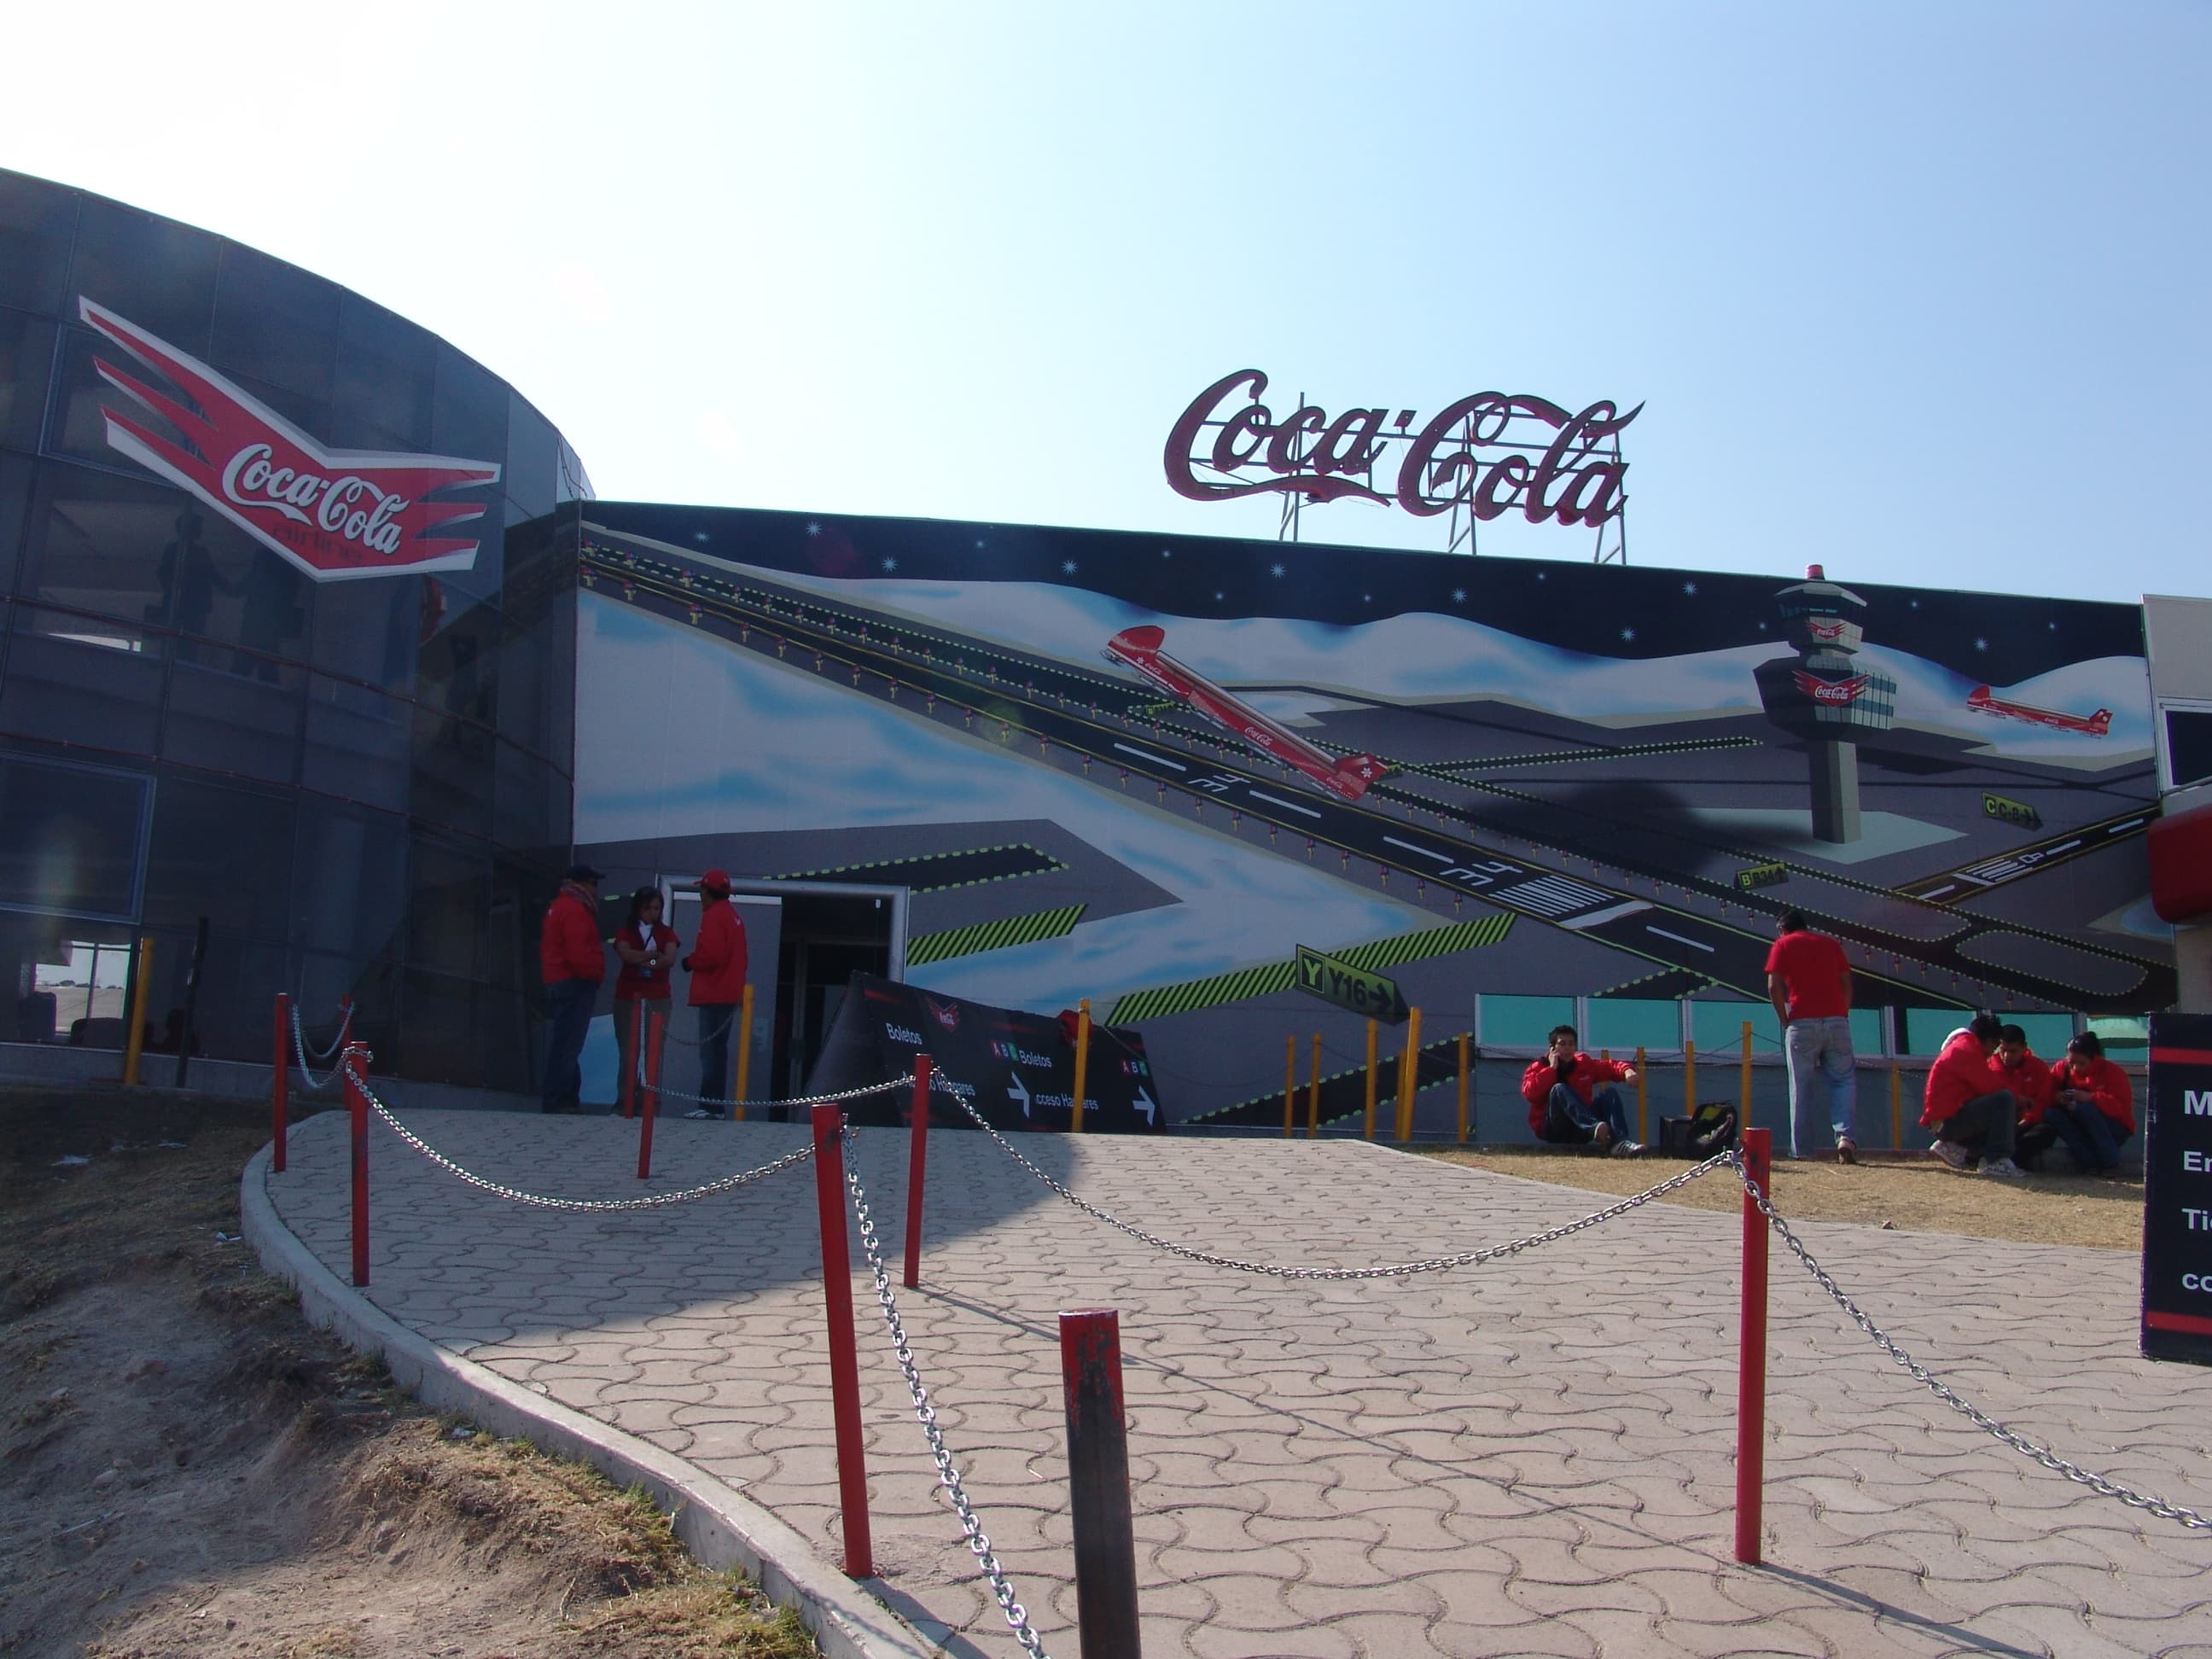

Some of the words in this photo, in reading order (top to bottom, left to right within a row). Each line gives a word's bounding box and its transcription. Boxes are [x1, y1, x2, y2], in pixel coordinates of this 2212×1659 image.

[1164, 369, 1646, 527] Coca-Cola
[222, 443, 410, 555] Coca-Cola
[1814, 684, 1850, 701] Coca-Cola
[1986, 800, 1996, 813] C
[1742, 874, 1751, 886] B
[1303, 957, 1322, 986] Y
[1327, 966, 1367, 1006] Y16
[886, 1022, 923, 1045] Boletos
[1019, 1050, 1052, 1068] Boletos
[2181, 1208, 2212, 1231] Ti
